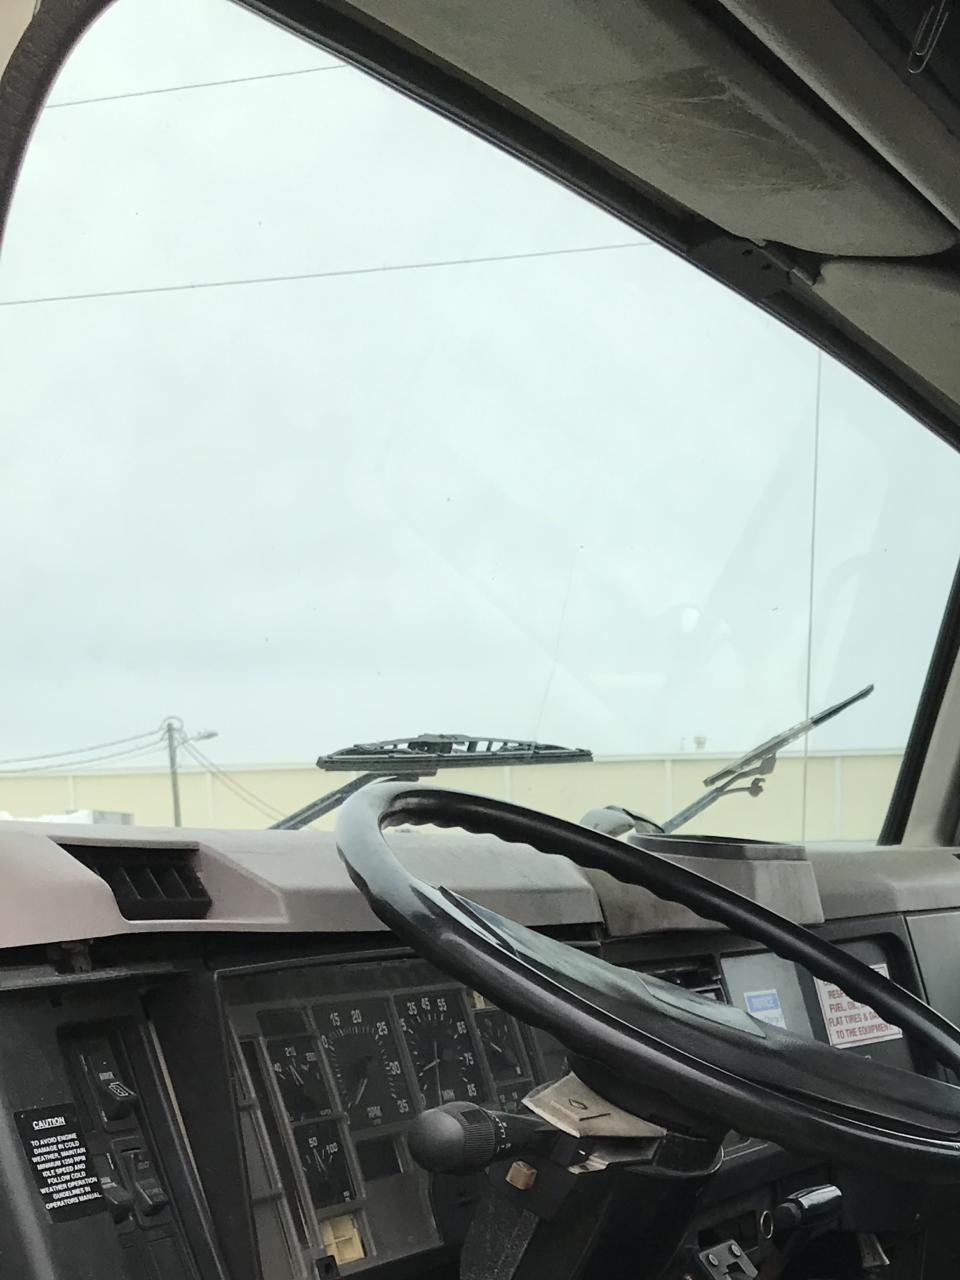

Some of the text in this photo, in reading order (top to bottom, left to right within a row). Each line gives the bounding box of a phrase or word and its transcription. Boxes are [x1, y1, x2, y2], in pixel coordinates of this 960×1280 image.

[407, 998, 447, 1015] 35 45 55
[330, 1009, 362, 1026] 15 20
[829, 1016, 843, 1028] FLAT
[844, 1013, 862, 1025] TIRES
[376, 1021, 388, 1035] 25
[457, 1021, 467, 1034] 65
[836, 1030, 846, 1040] TO
[846, 1028, 858, 1038] THE
[464, 1052, 474, 1066] 75
[389, 1061, 401, 1075] 30
[467, 1083, 477, 1097] 85
[396, 1099, 408, 1113] 35
[32, 1116, 66, 1130] CAUTION
[40, 1136, 57, 1145] AVOID
[58, 1132, 77, 1142] ENGINE
[308, 1137, 318, 1148] 50
[33, 1145, 58, 1155] DAMAGE
[64, 1140, 80, 1148] COLD
[60, 1147, 86, 1157] MAINTAIN
[325, 1142, 338, 1154] 100
[37, 1160, 61, 1171] MINIMUM
[74, 1155, 86, 1163] RPM
[42, 1169, 55, 1177] IDLE
[56, 1166, 74, 1175] SPEED
[47, 1171, 86, 1184] FOLLOW COLD
[40, 1184, 67, 1194] WEATHER
[68, 1177, 98, 1188] OPERATION
[53, 1188, 84, 1199] GUIDELINES
[45, 1197, 79, 1210] OPERATORS
